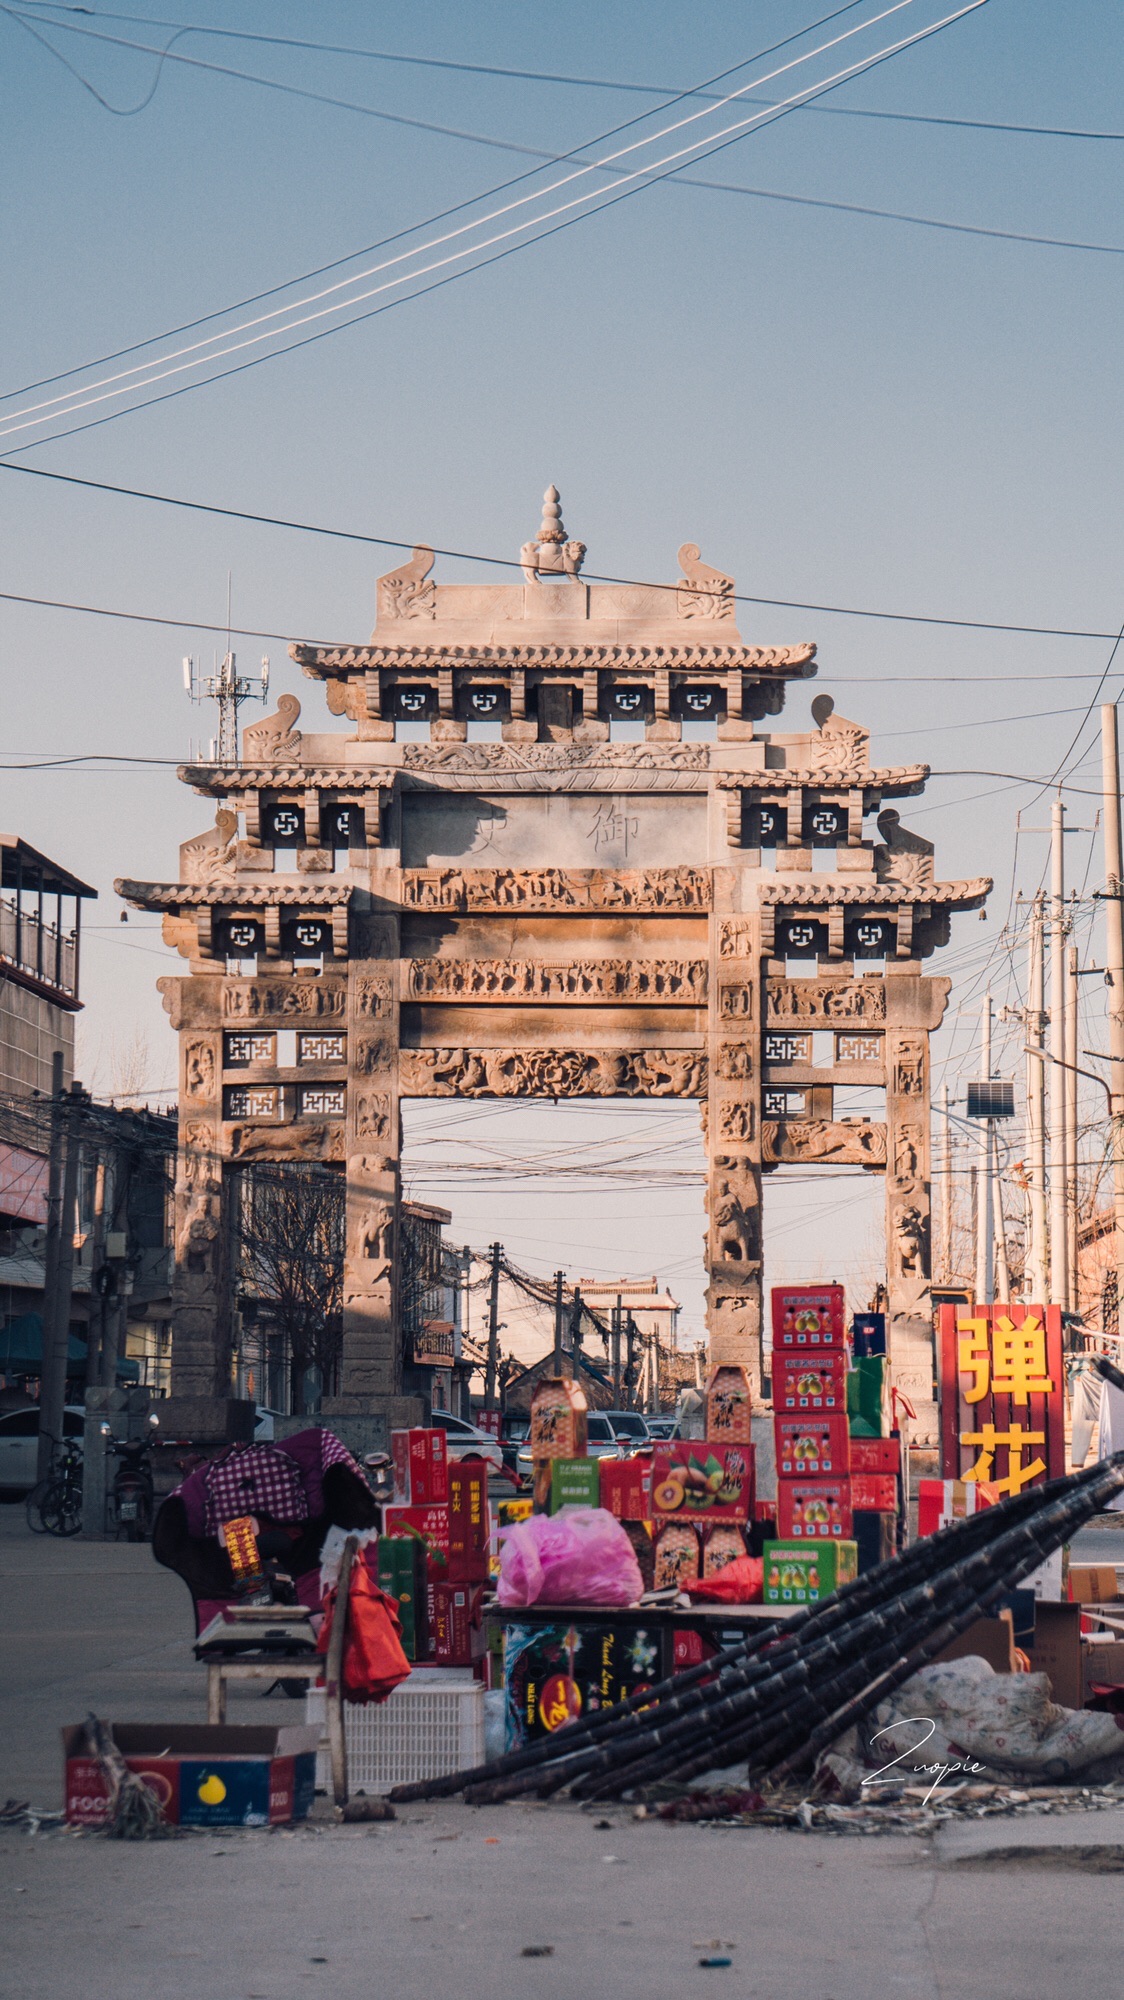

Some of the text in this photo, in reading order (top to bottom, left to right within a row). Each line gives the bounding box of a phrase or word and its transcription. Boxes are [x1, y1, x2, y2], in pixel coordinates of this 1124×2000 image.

[957, 1315, 1053, 1497] 弹花
[602, 1633, 615, 1665] Thanh
[600, 1668, 614, 1695] Long
